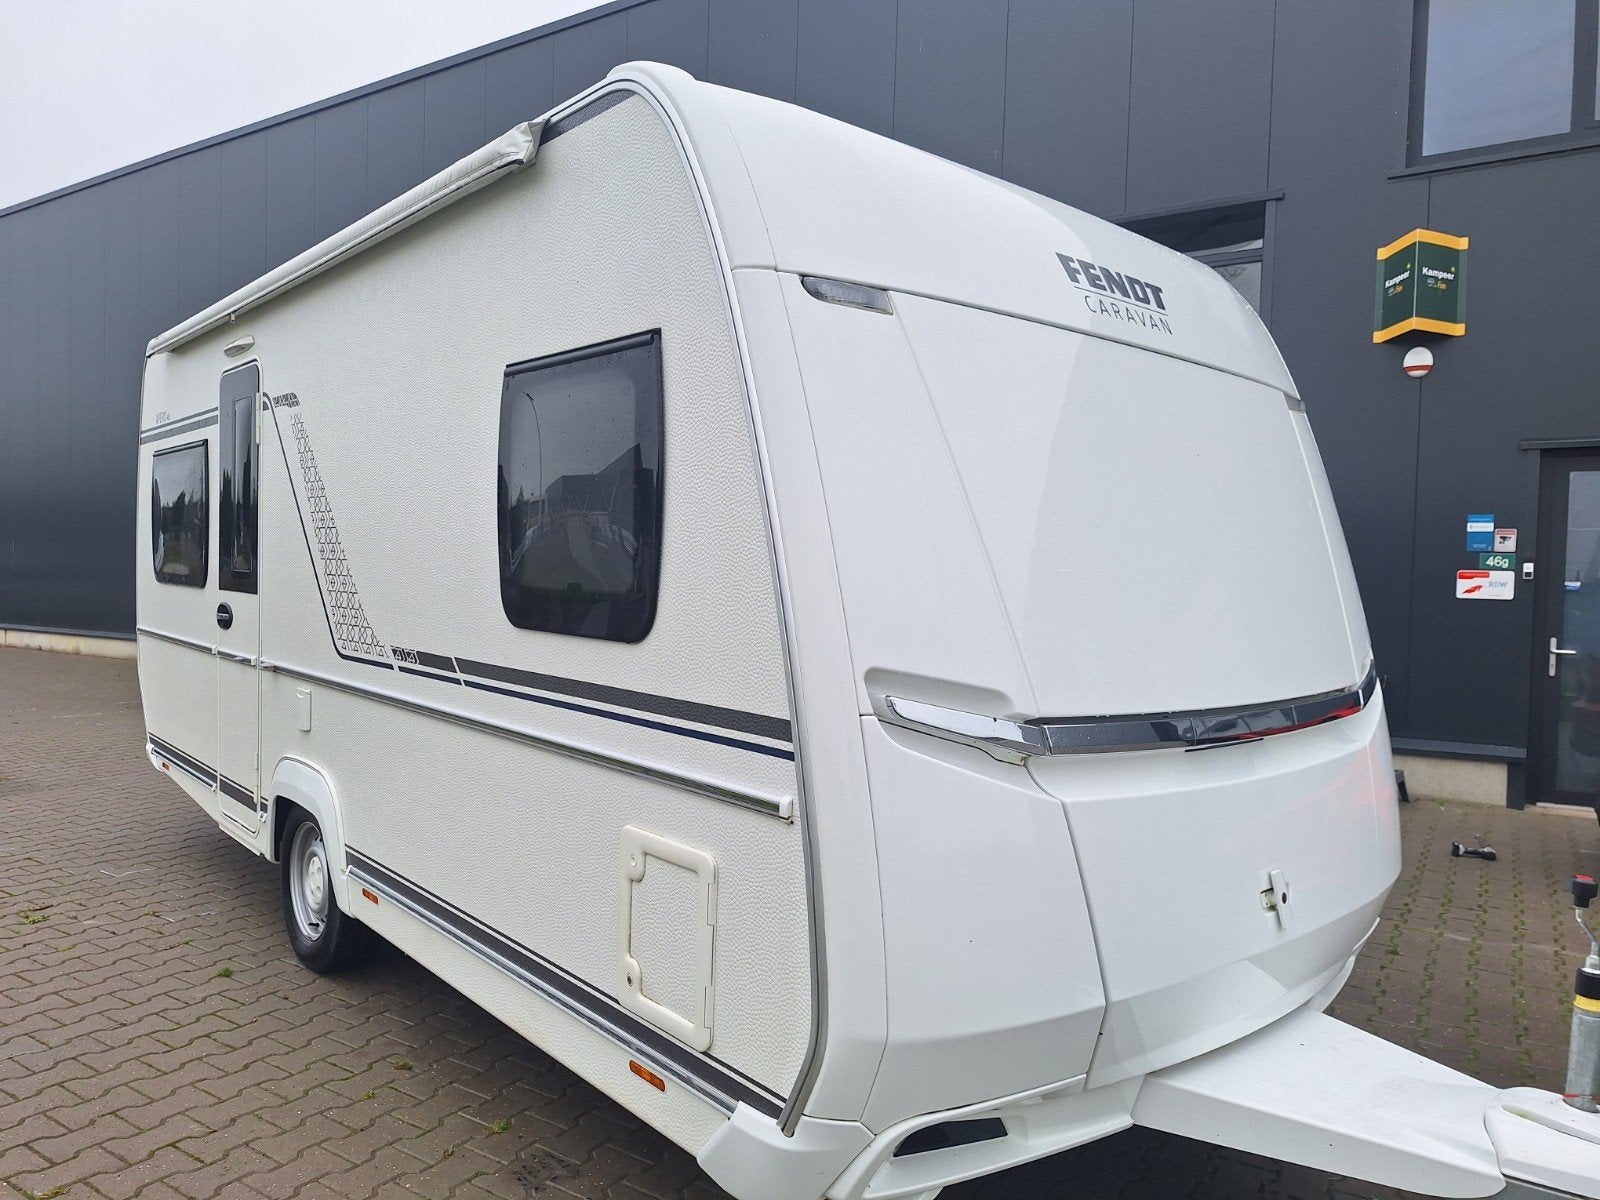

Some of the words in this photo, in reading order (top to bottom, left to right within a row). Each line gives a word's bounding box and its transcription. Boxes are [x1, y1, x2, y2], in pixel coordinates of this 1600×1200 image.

[1055, 252, 1166, 310] FENDT
[1385, 270, 1410, 288] Kampeer
[1422, 267, 1455, 280] Kampeer
[1084, 295, 1173, 335] CARAVAN
[1485, 556, 1509, 568] 46g
